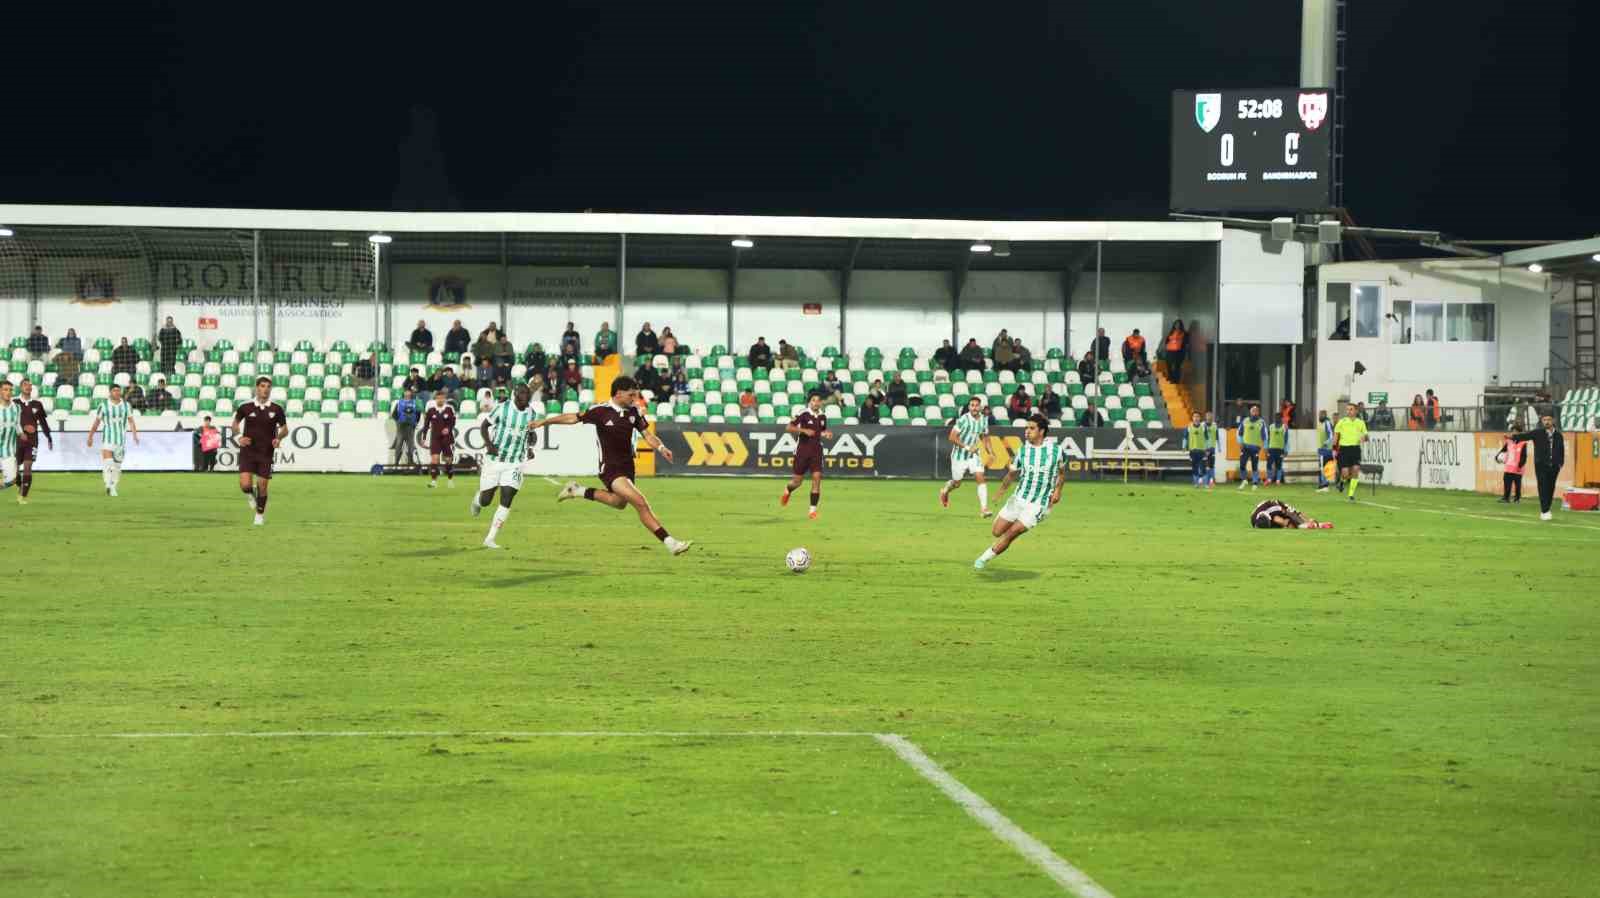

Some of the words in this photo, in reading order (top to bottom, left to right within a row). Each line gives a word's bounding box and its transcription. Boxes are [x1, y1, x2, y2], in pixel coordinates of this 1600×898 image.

[1238, 99, 1283, 119] 52:08
[1220, 133, 1234, 166] 0
[749, 432, 887, 456] TAAY
[1046, 435, 1169, 459] ALAY
[1419, 435, 1461, 467] ACROPOL
